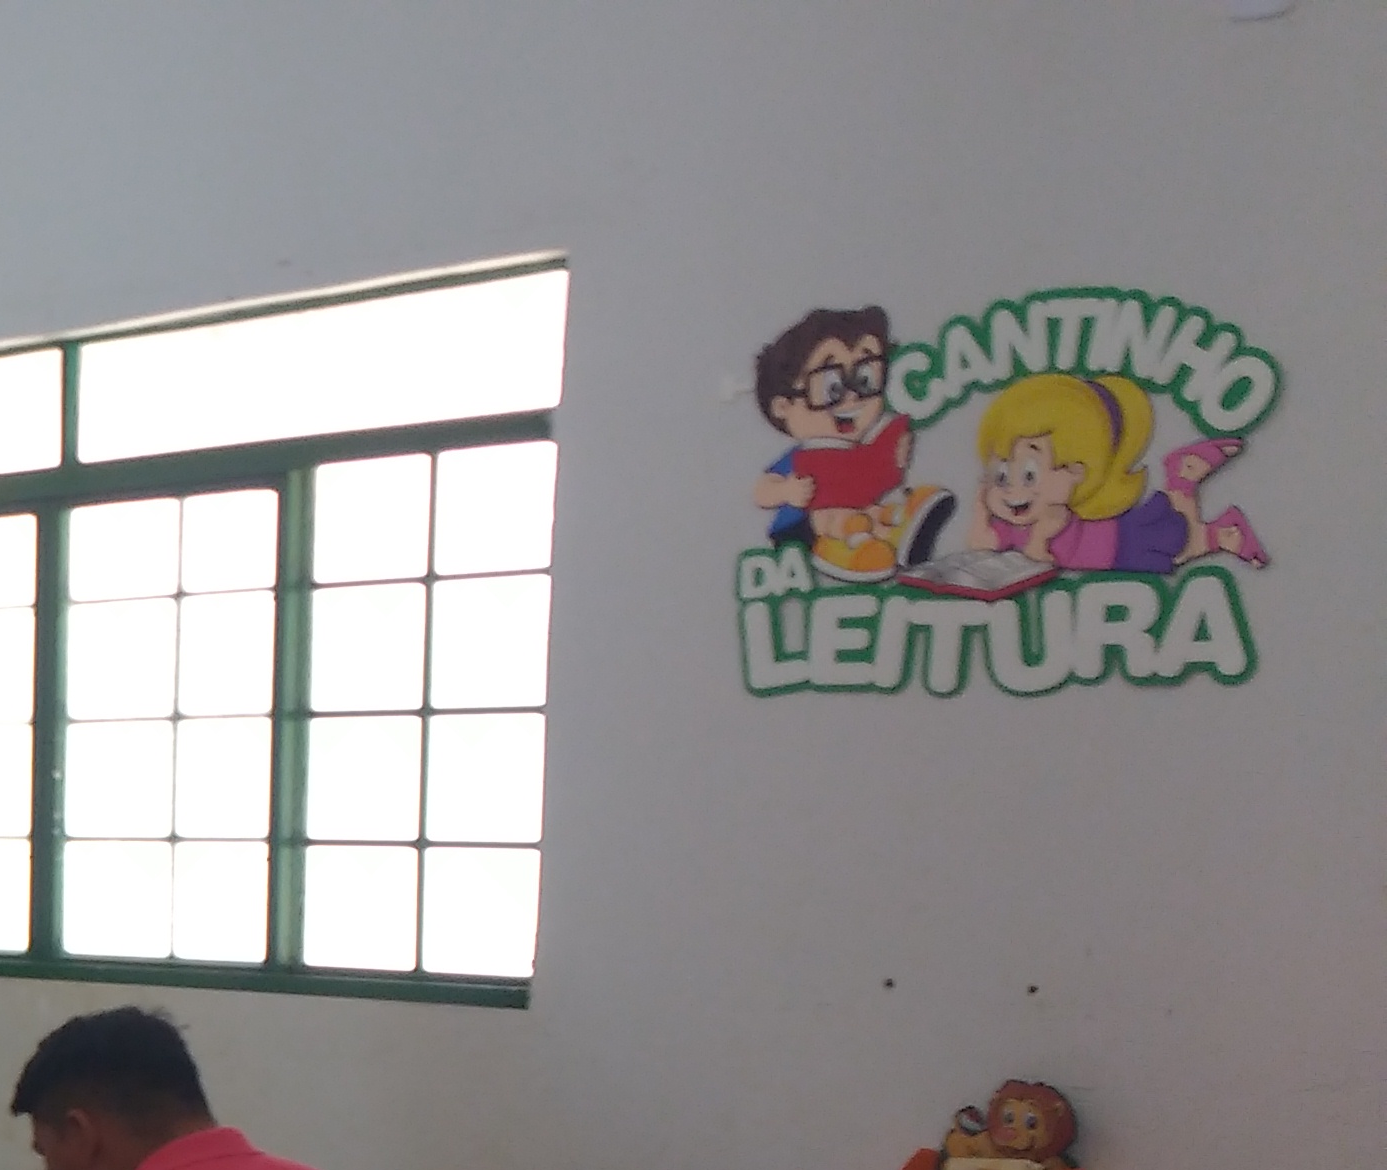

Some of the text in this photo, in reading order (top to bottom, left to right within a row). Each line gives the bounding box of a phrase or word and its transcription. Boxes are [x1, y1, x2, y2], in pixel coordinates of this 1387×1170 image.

[888, 290, 1280, 436] CANTINHO
[740, 569, 1254, 694] LEITURA
[741, 548, 814, 599] DA
